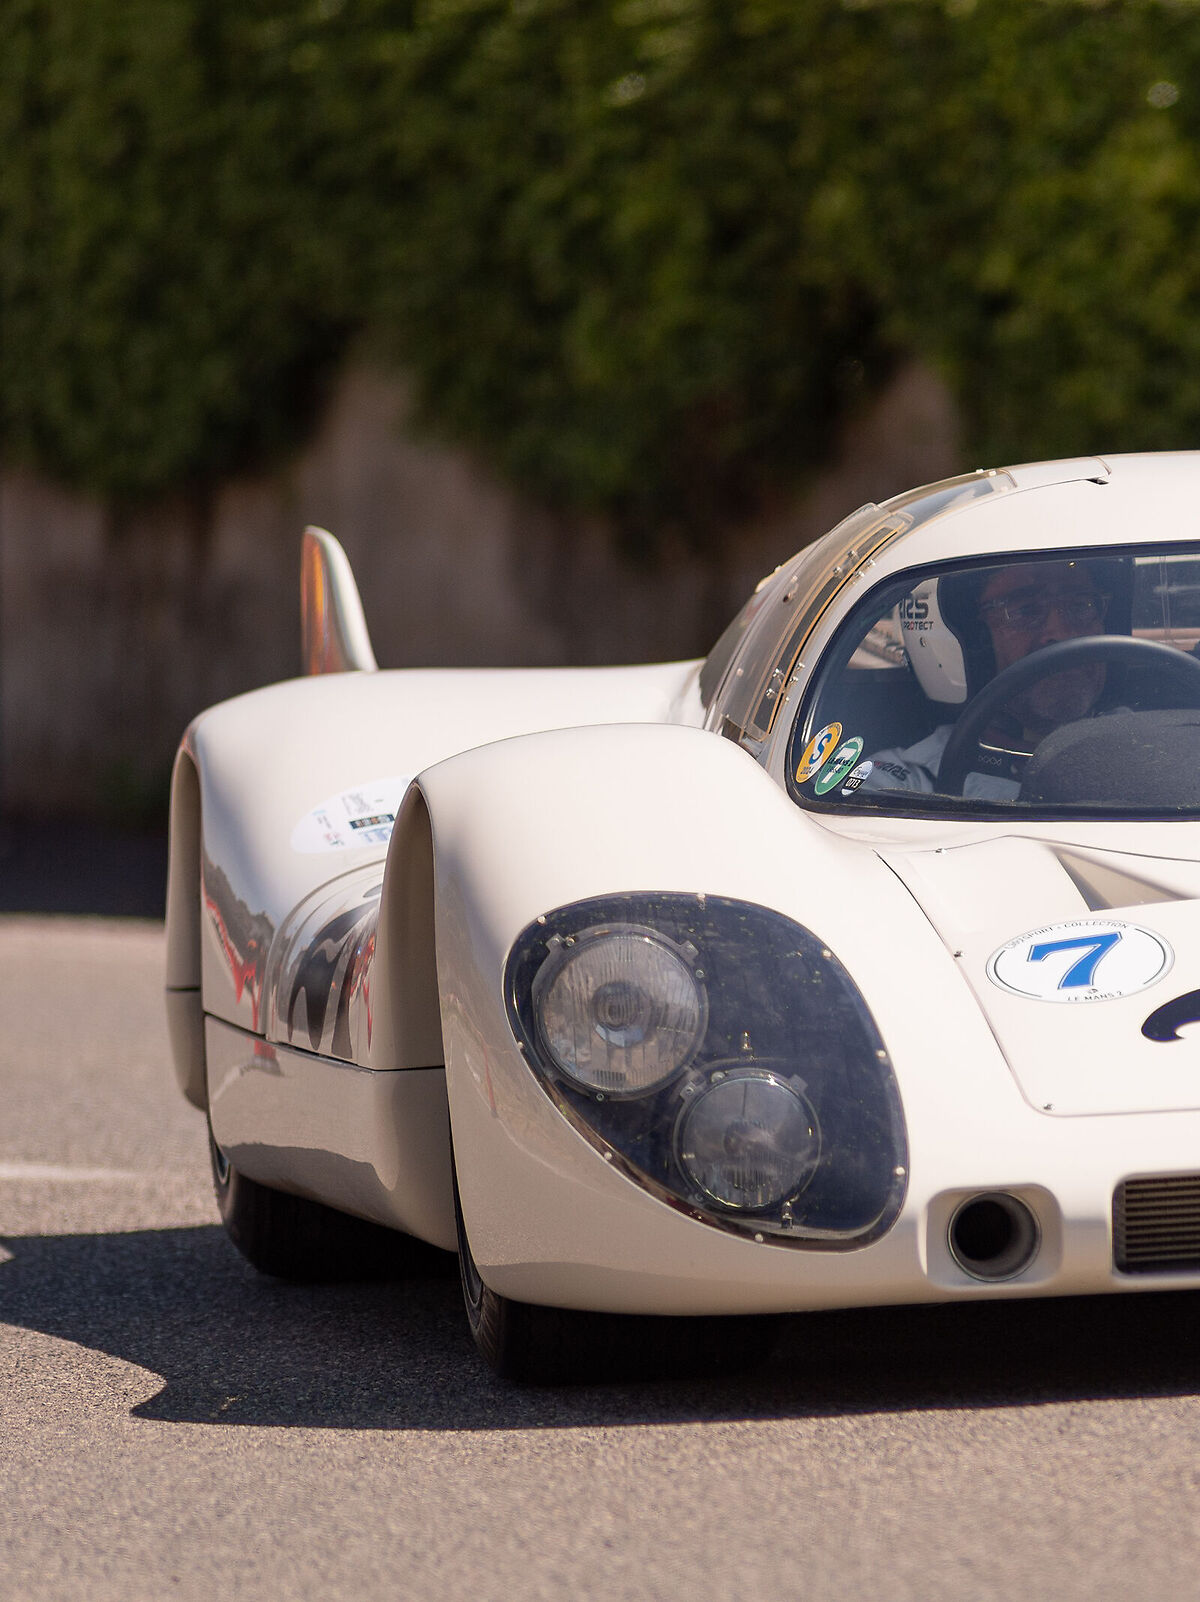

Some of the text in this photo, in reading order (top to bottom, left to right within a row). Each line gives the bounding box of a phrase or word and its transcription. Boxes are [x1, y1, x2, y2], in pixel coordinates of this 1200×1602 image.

[808, 733, 833, 765] S
[1064, 920, 1128, 929] COLLECTION
[1027, 931, 1123, 990] 7
[1084, 992, 1115, 1001] MANS
